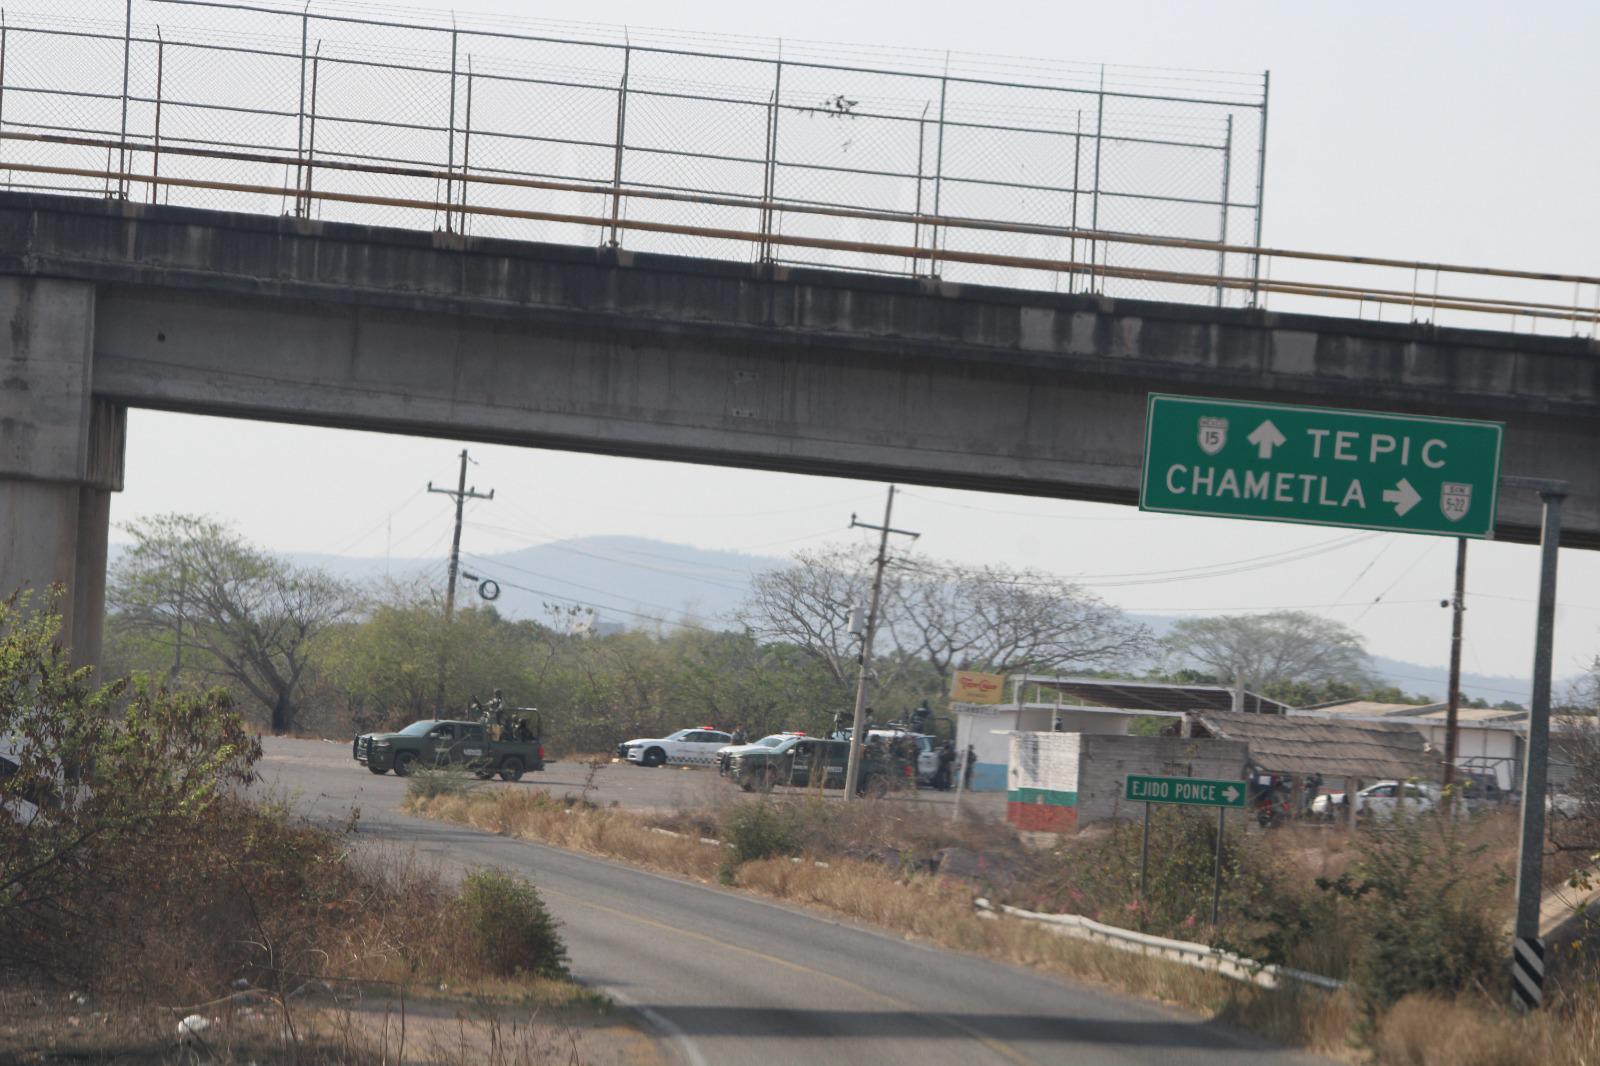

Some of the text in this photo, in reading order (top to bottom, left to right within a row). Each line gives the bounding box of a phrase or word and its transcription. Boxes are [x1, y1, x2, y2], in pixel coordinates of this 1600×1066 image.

[1205, 431, 1218, 445] 15
[1307, 428, 1448, 469] TEPIC
[1166, 464, 1367, 509] CHAMETLA
[1132, 780, 1217, 801] EJIDO PONCE
